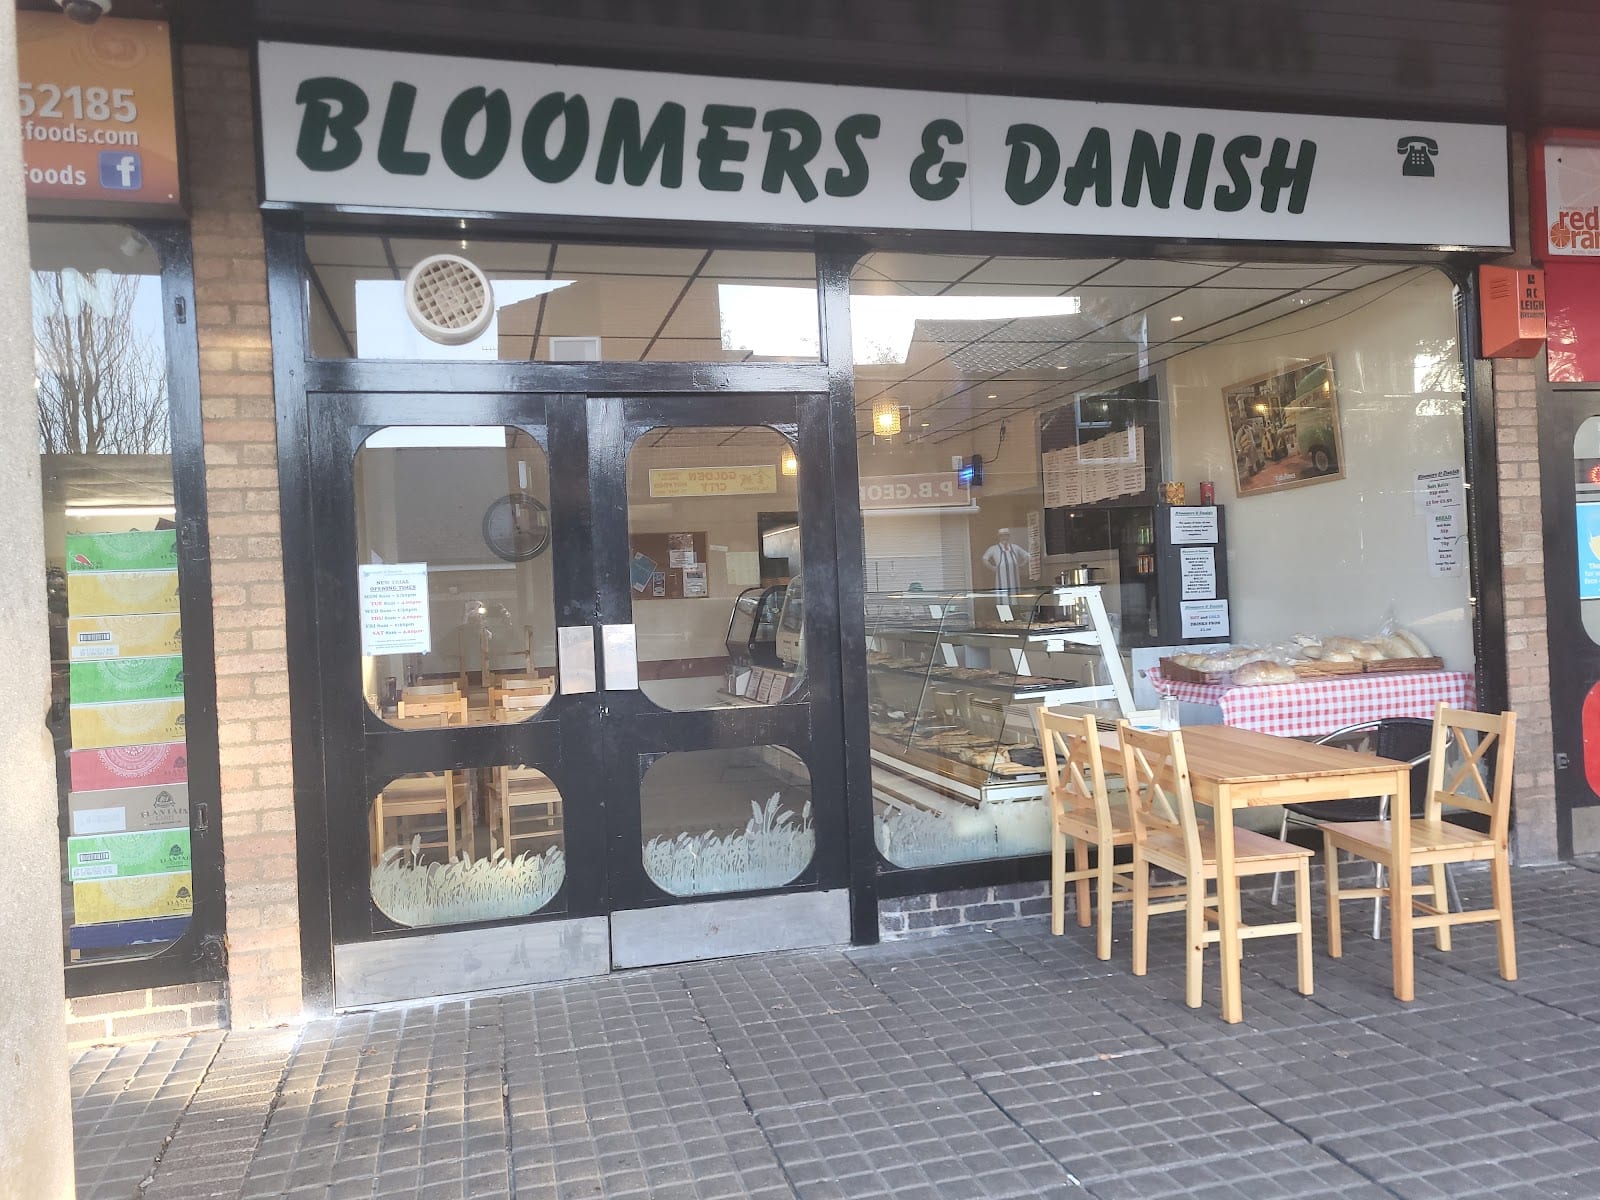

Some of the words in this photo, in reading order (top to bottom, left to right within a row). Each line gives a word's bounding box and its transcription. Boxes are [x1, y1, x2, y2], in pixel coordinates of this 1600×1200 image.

[21, 121, 139, 146] foods.com
[295, 76, 880, 203] BLOOMERS
[909, 118, 967, 201] &
[1005, 123, 1317, 215] DANISH
[1559, 206, 1599, 231] red
[1520, 300, 1544, 310] LEIGH
